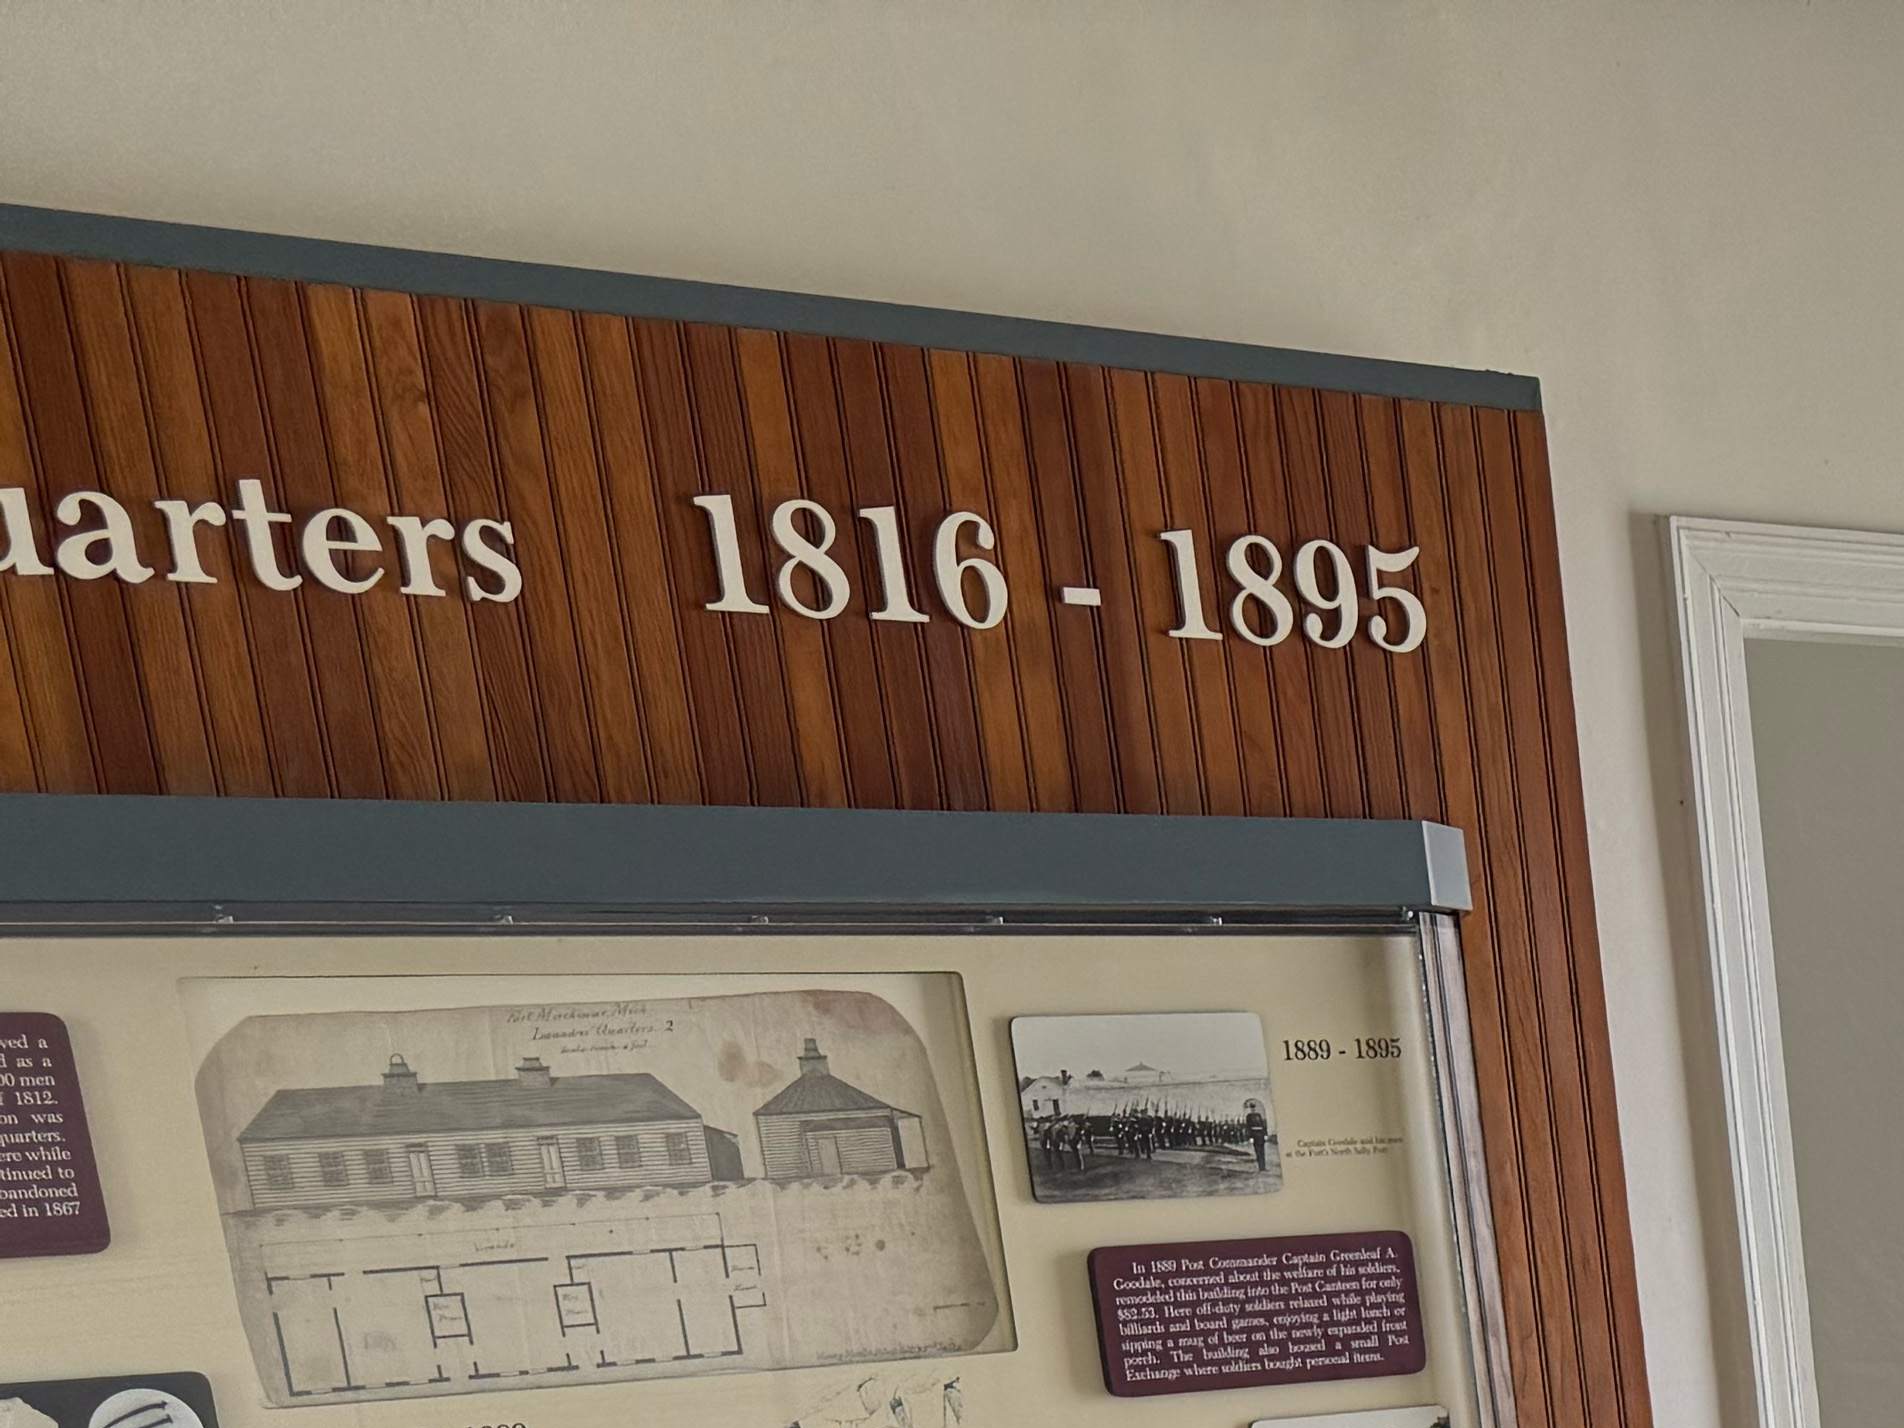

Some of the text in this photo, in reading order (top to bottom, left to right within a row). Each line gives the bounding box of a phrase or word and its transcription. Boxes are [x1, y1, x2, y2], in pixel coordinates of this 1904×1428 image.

[686, 492, 1009, 631] 1816
[1061, 585, 1102, 607] -
[1157, 528, 1427, 654] 1895
[664, 1019, 674, 1032] 2
[38, 1038, 48, 1049] a
[1283, 1038, 1331, 1061] 1889
[1354, 1037, 1402, 1059] 1895
[16, 1057, 33, 1068] as
[42, 1057, 52, 1067] a
[20, 1075, 56, 1086] men
[15, 1091, 58, 1105] 1812.
[31, 1113, 64, 1124] was
[25, 1146, 72, 1161] while
[57, 1167, 75, 1179] to
[22, 1203, 39, 1217] in
[44, 1201, 81, 1217] 1867
[1181, 1259, 1204, 1271] Post
[1208, 1254, 1277, 1268] Commander
[1281, 1252, 1325, 1266] Captain
[1329, 1247, 1380, 1261] Greenleaf
[1228, 1270, 1259, 1283] about
[1115, 1290, 1174, 1305] remodeled
[1176, 1289, 1196, 1301] this
[1198, 1286, 1245, 1299] building
[1247, 1285, 1269, 1297] into
[1290, 1281, 1312, 1294] Post
[1314, 1279, 1359, 1292] Canteen
[1379, 1275, 1400, 1289] only
[1123, 1352, 1160, 1369] porch.
[1169, 1349, 1192, 1362] The
[1202, 1346, 1249, 1359] building
[1258, 1343, 1279, 1355] also
[1288, 1339, 1325, 1353] housed
[1350, 1335, 1378, 1348] small
[1387, 1333, 1409, 1345] Post
[1125, 1367, 1180, 1381] Exchange
[1183, 1363, 1218, 1376] where
[1221, 1360, 1261, 1373] soldiers
[1264, 1356, 1302, 1369] bought
[1305, 1352, 1349, 1369] personal
